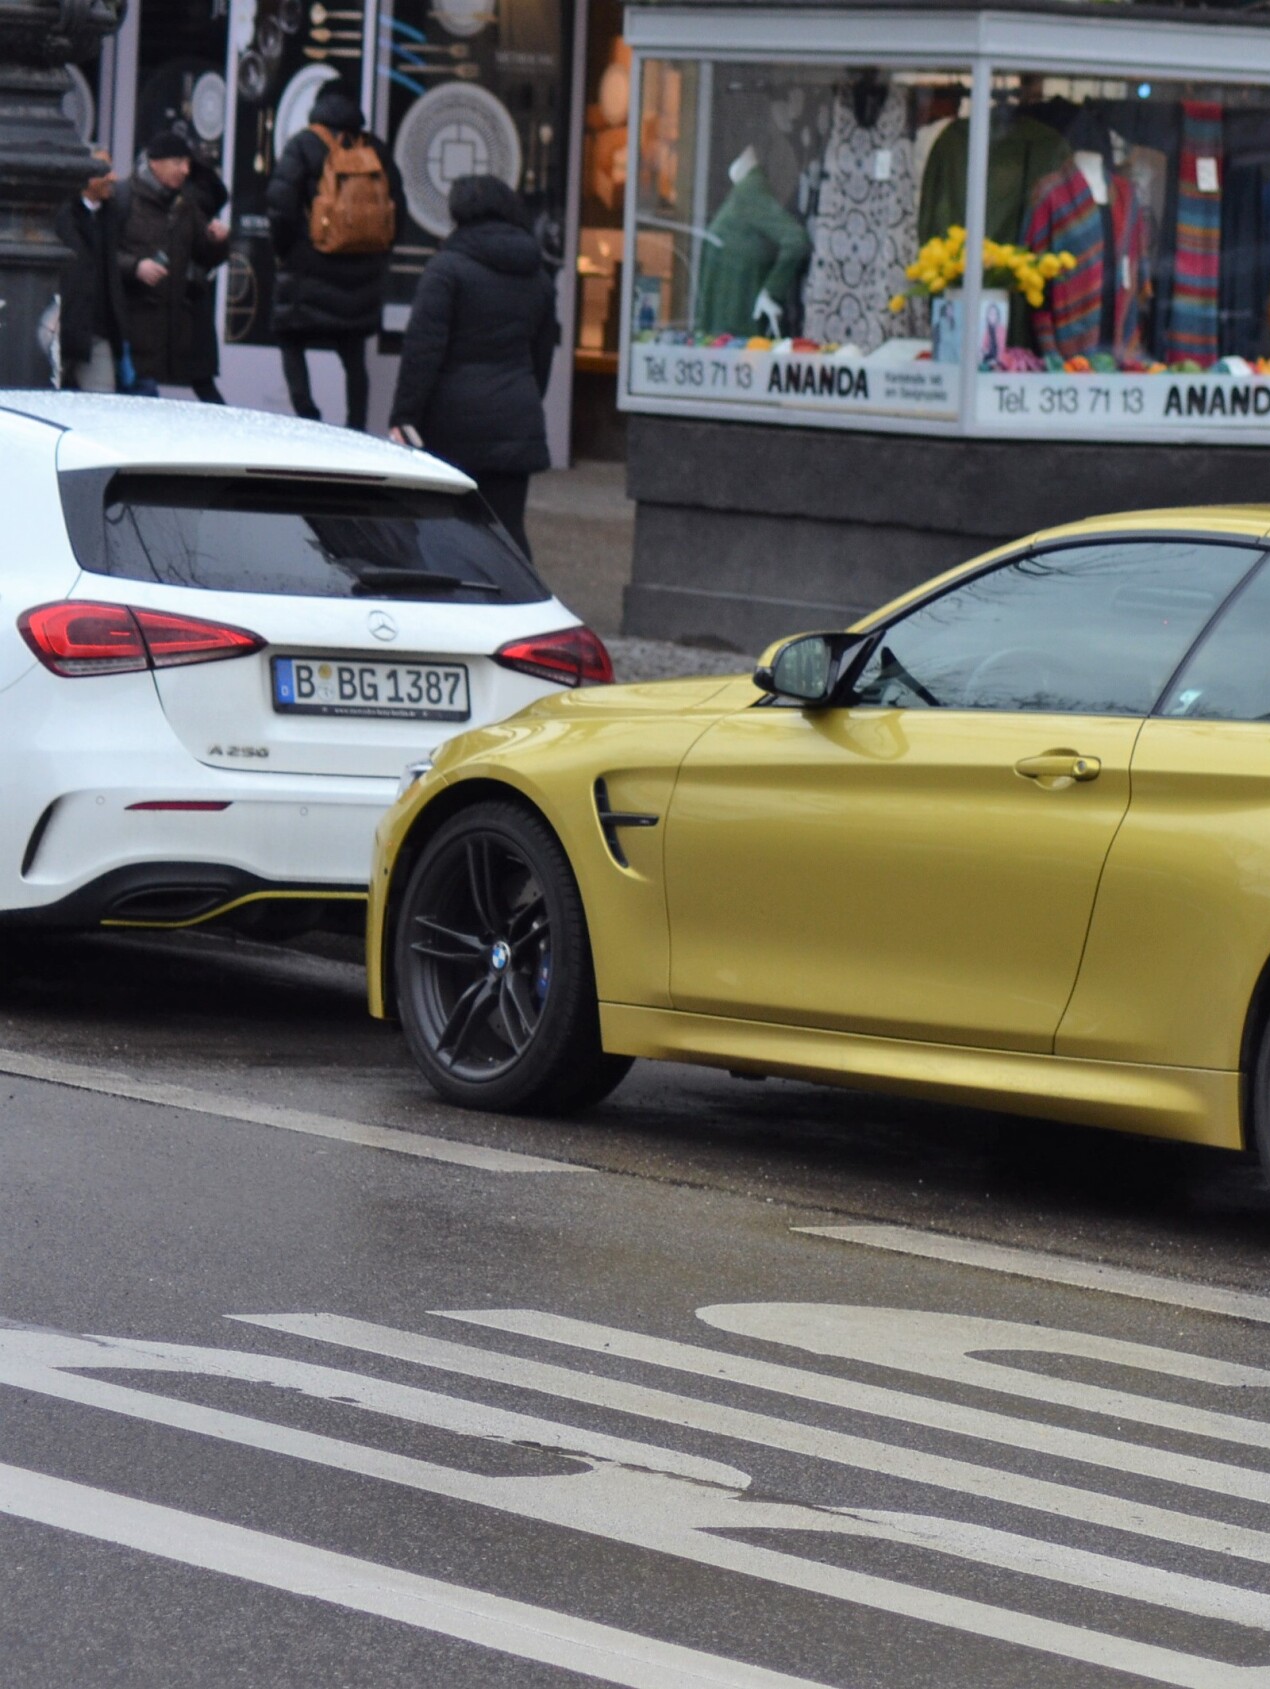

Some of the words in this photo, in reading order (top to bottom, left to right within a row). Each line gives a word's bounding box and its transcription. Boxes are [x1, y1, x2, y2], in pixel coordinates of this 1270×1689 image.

[644, 356, 667, 384] Tel.
[674, 359, 704, 387] 313
[711, 361, 728, 387] 71
[735, 363, 751, 389] 13
[768, 362, 869, 399] ANANDA
[994, 385, 1028, 413] Tel.
[1038, 387, 1078, 414] 313
[1088, 388, 1110, 415] 71
[1121, 388, 1144, 414] 13
[295, 665, 316, 699] B
[337, 668, 379, 702] BG
[386, 669, 460, 705] 1387
